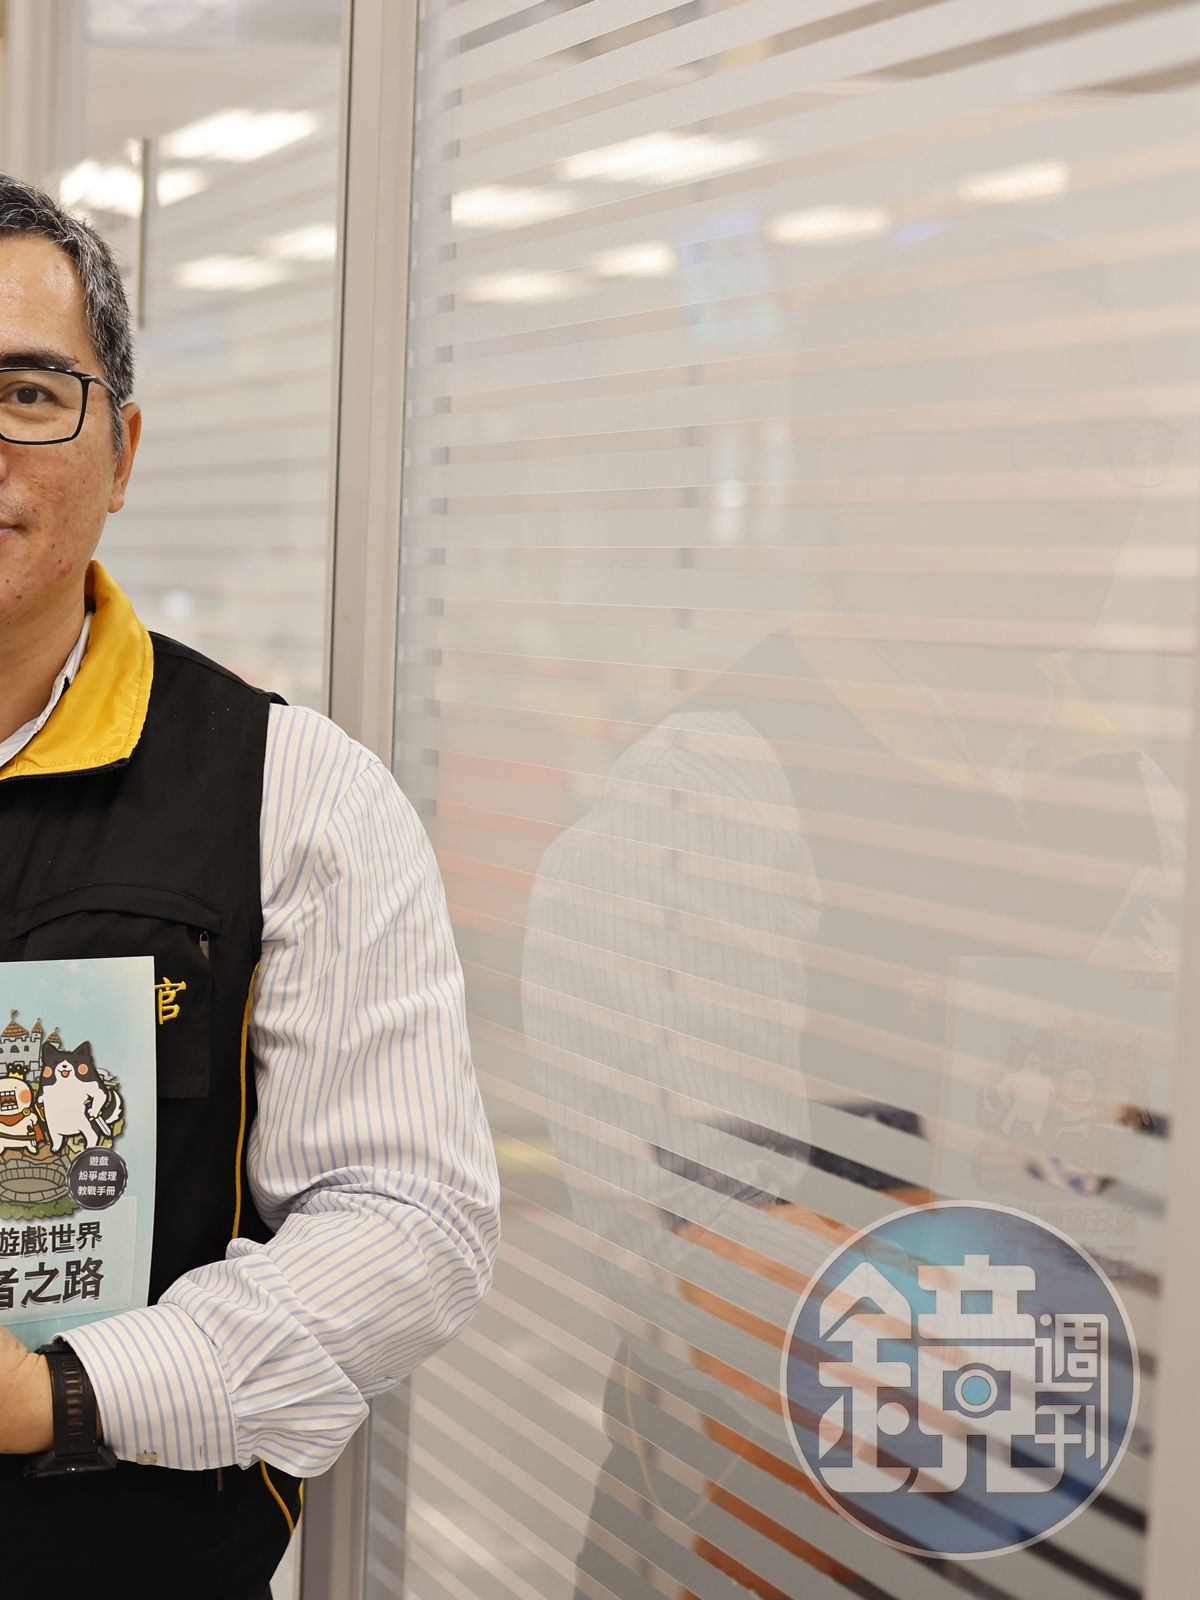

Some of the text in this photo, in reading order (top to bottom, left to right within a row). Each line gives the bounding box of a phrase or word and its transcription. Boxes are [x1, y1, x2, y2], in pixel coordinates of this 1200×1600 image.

[153, 977, 187, 1025] 官
[78, 1170, 118, 1181] 紛爭處理
[77, 1186, 116, 1196] 教戰手冊
